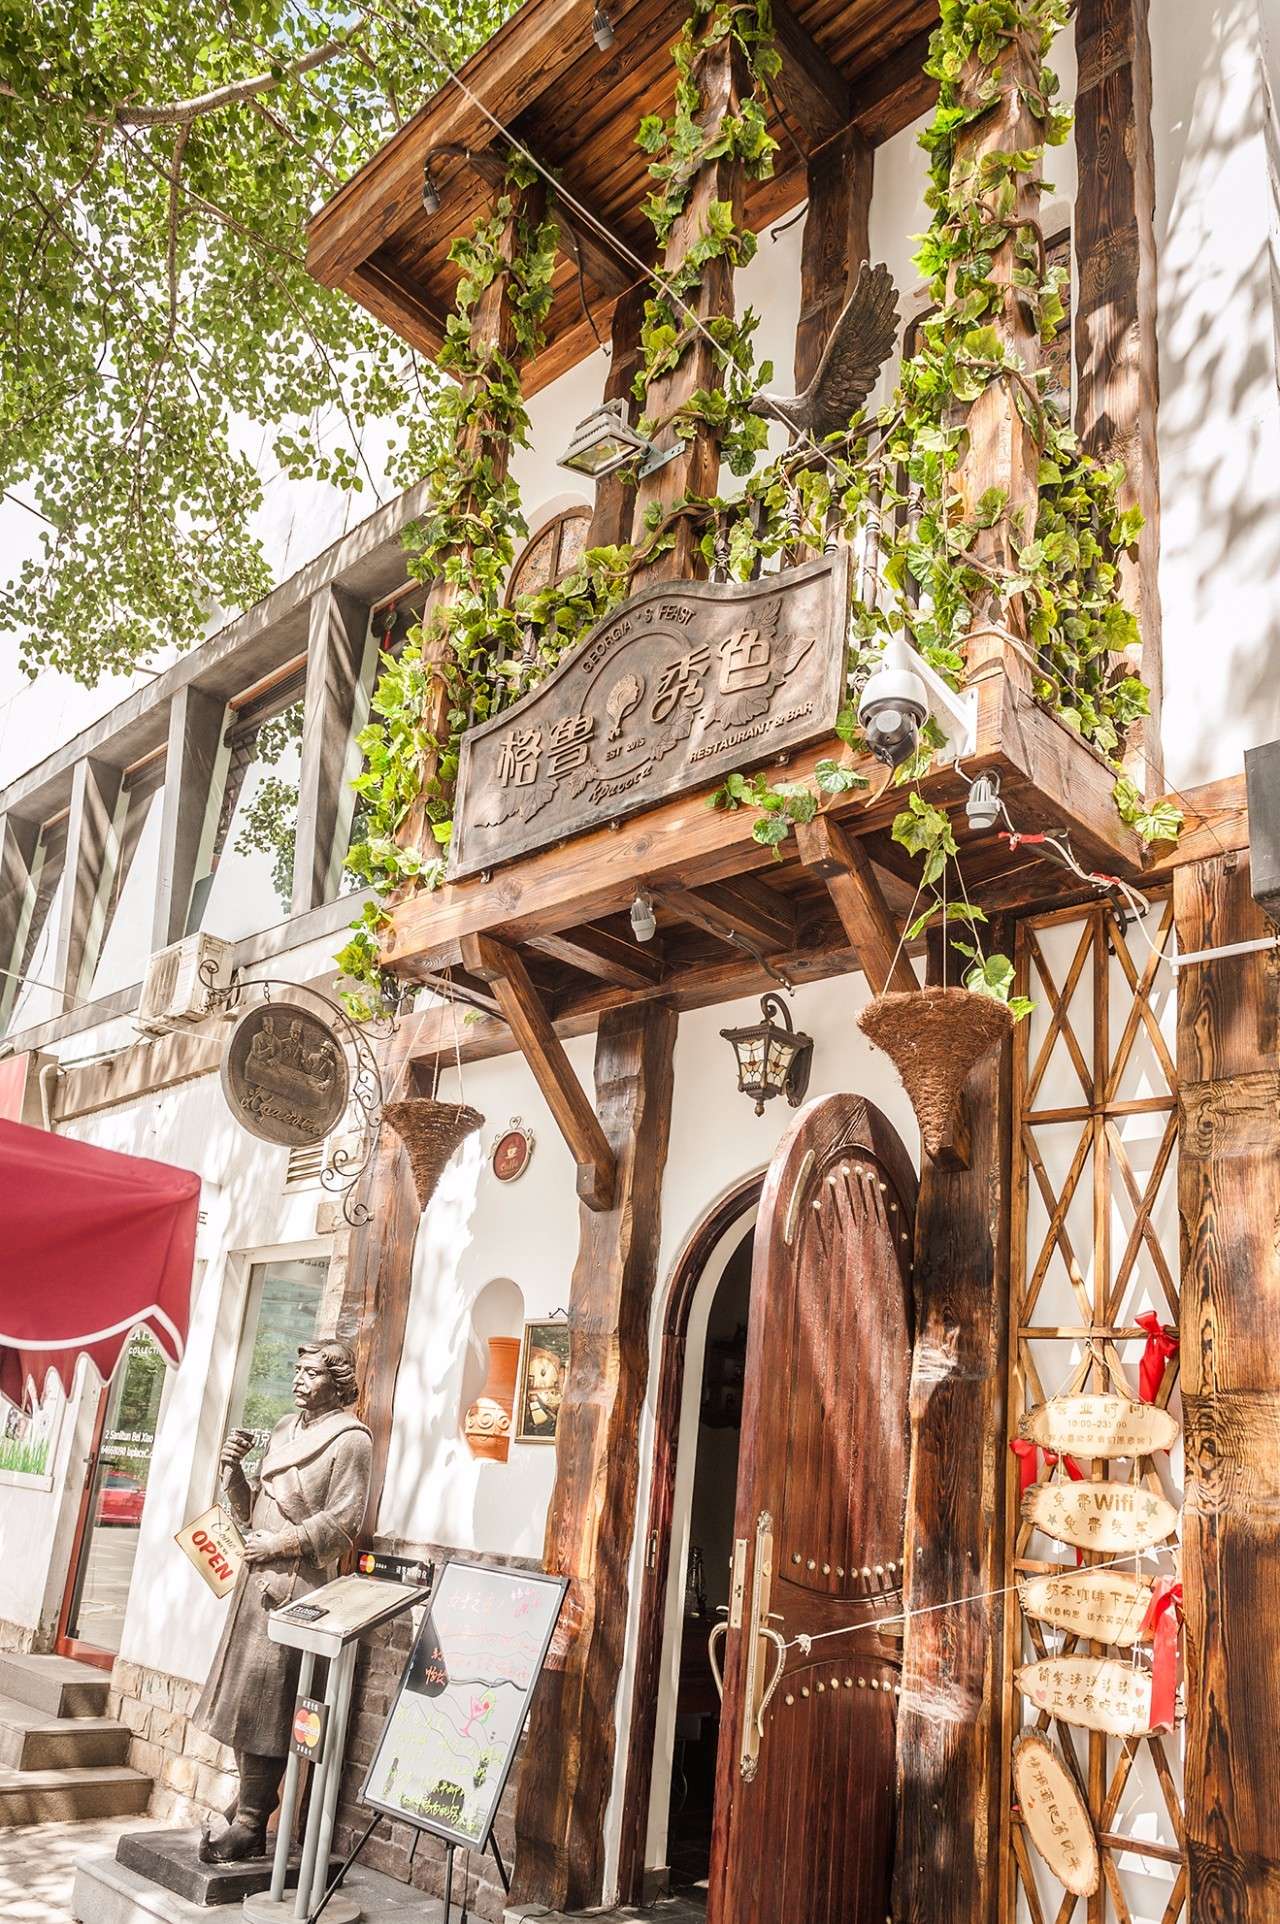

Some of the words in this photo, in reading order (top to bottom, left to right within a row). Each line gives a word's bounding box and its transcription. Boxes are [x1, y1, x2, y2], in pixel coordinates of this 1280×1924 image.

[582, 620, 632, 674] GEORGIA
[659, 604, 697, 626] FEAST
[605, 747, 622, 762] EST
[626, 737, 646, 753] 2015
[690, 720, 772, 763] RESTAURANT
[774, 714, 785, 728] &
[786, 702, 814, 723] BAR
[191, 1530, 234, 1581] OPEN
